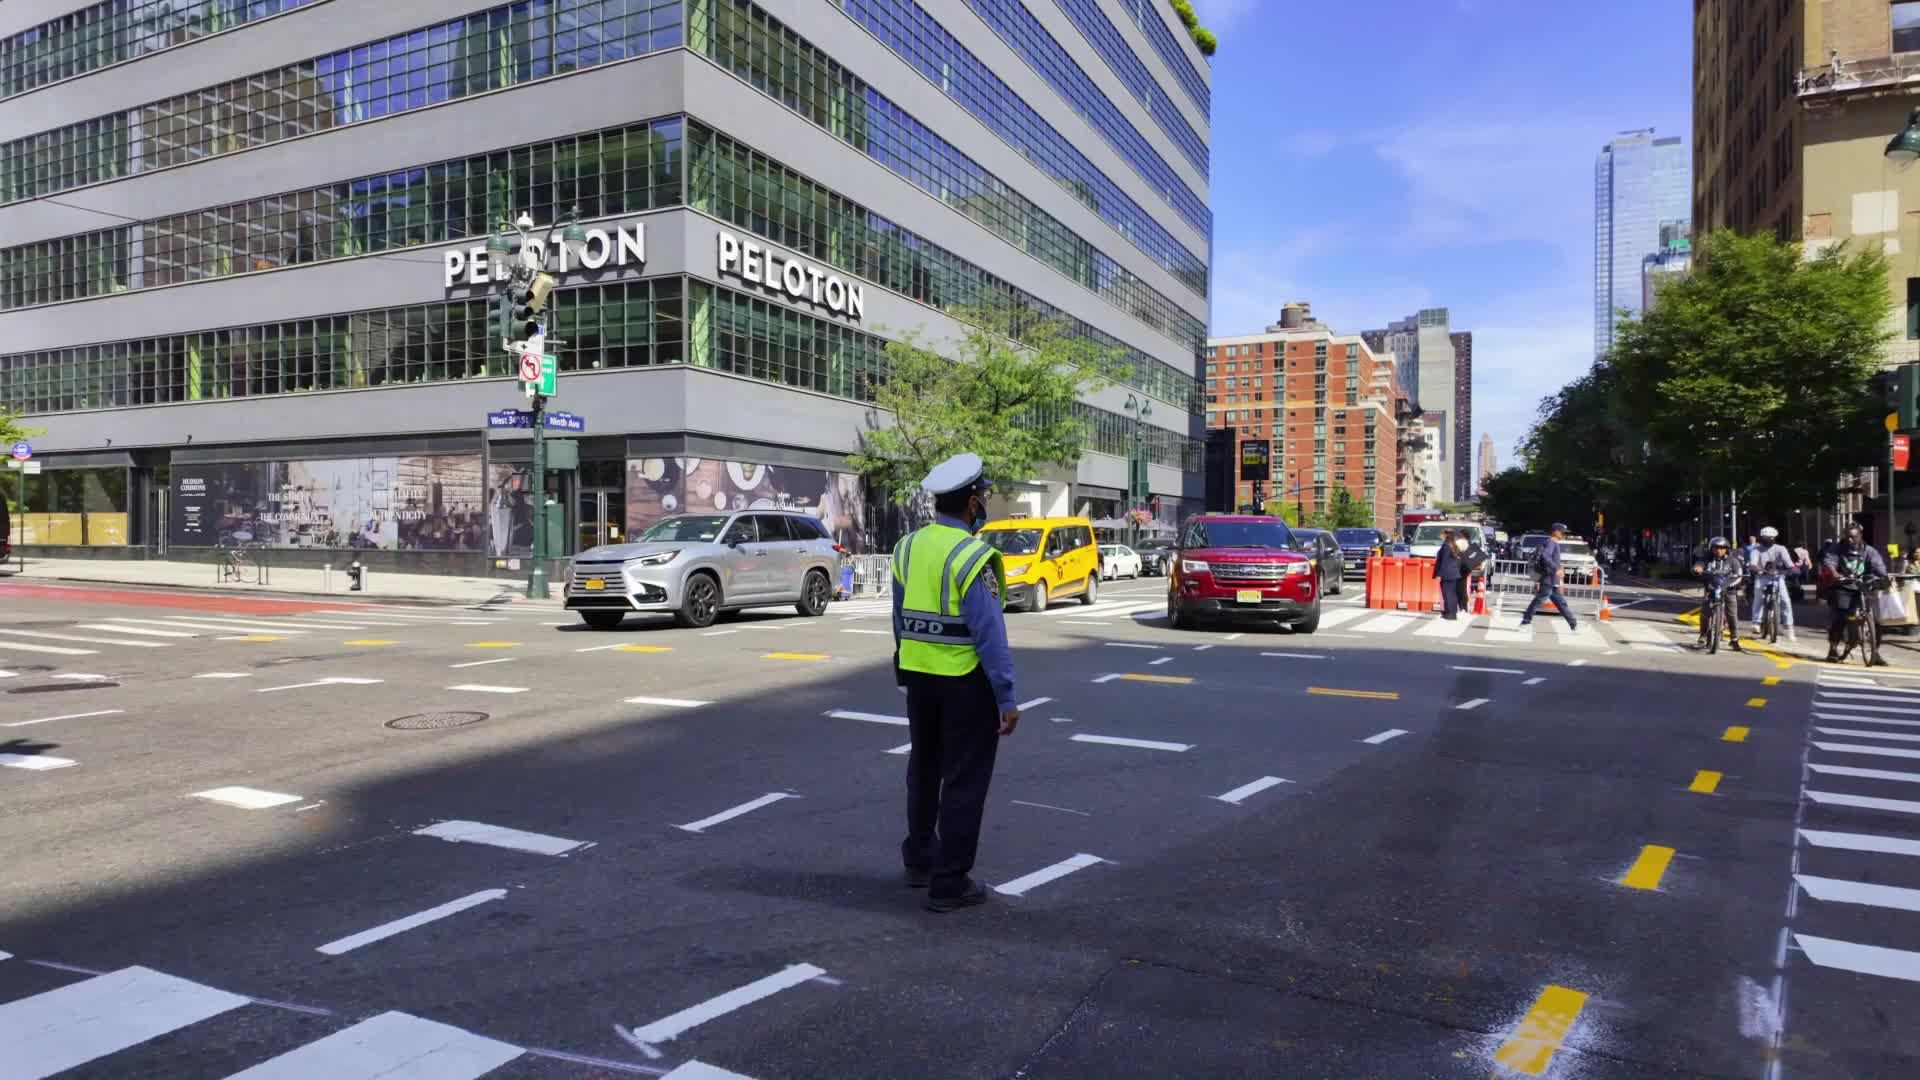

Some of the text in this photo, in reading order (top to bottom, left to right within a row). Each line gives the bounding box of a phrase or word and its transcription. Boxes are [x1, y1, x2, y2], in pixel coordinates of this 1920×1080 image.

[718, 231, 864, 319] PELOTON
[490, 416, 508, 425] West
[549, 416, 580, 429] Ninth Ave
[268, 492, 280, 502] THE
[260, 512, 273, 521] THE
[370, 511, 427, 521] AUTHENTICITY
[903, 618, 944, 634] YPD
